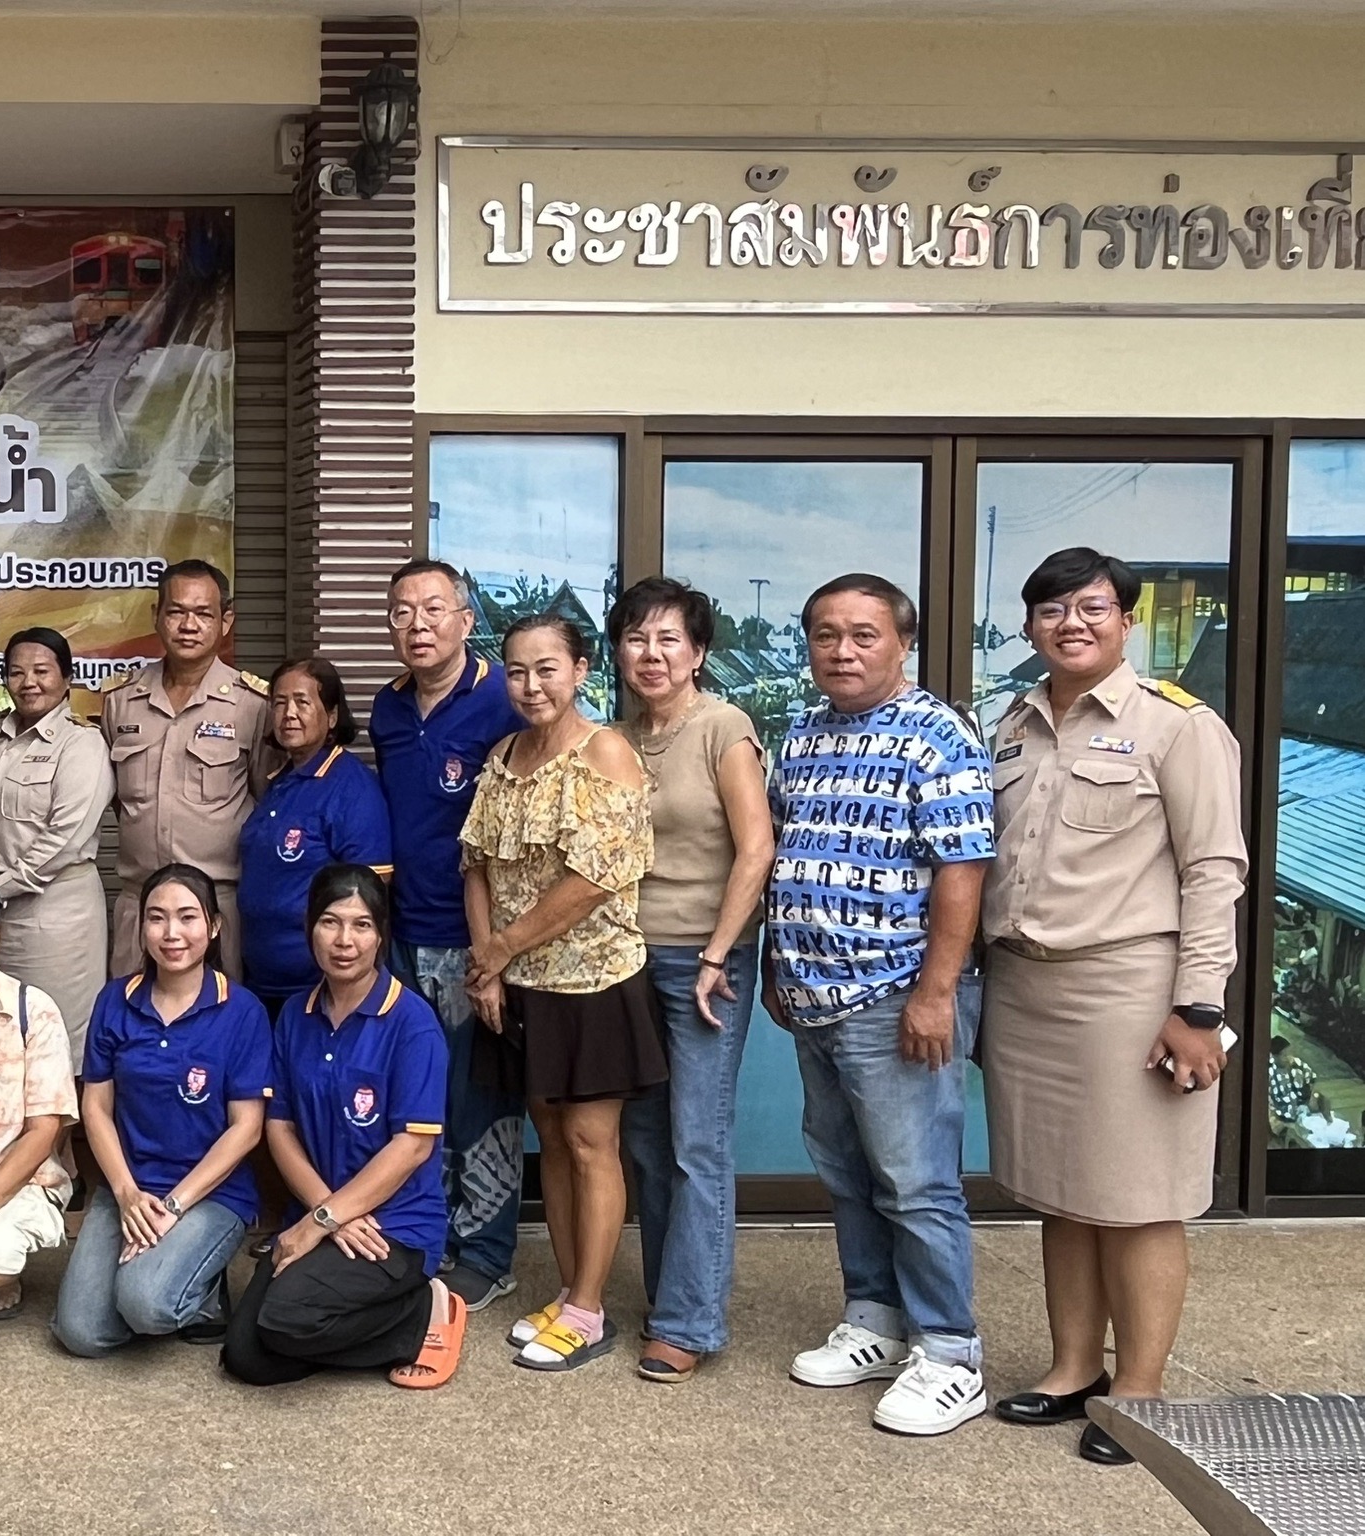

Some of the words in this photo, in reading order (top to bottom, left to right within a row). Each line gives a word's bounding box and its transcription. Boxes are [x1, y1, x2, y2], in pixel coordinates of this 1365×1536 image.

[480, 153, 1365, 269] ประชาสัมพันธ์การท่องเที่
